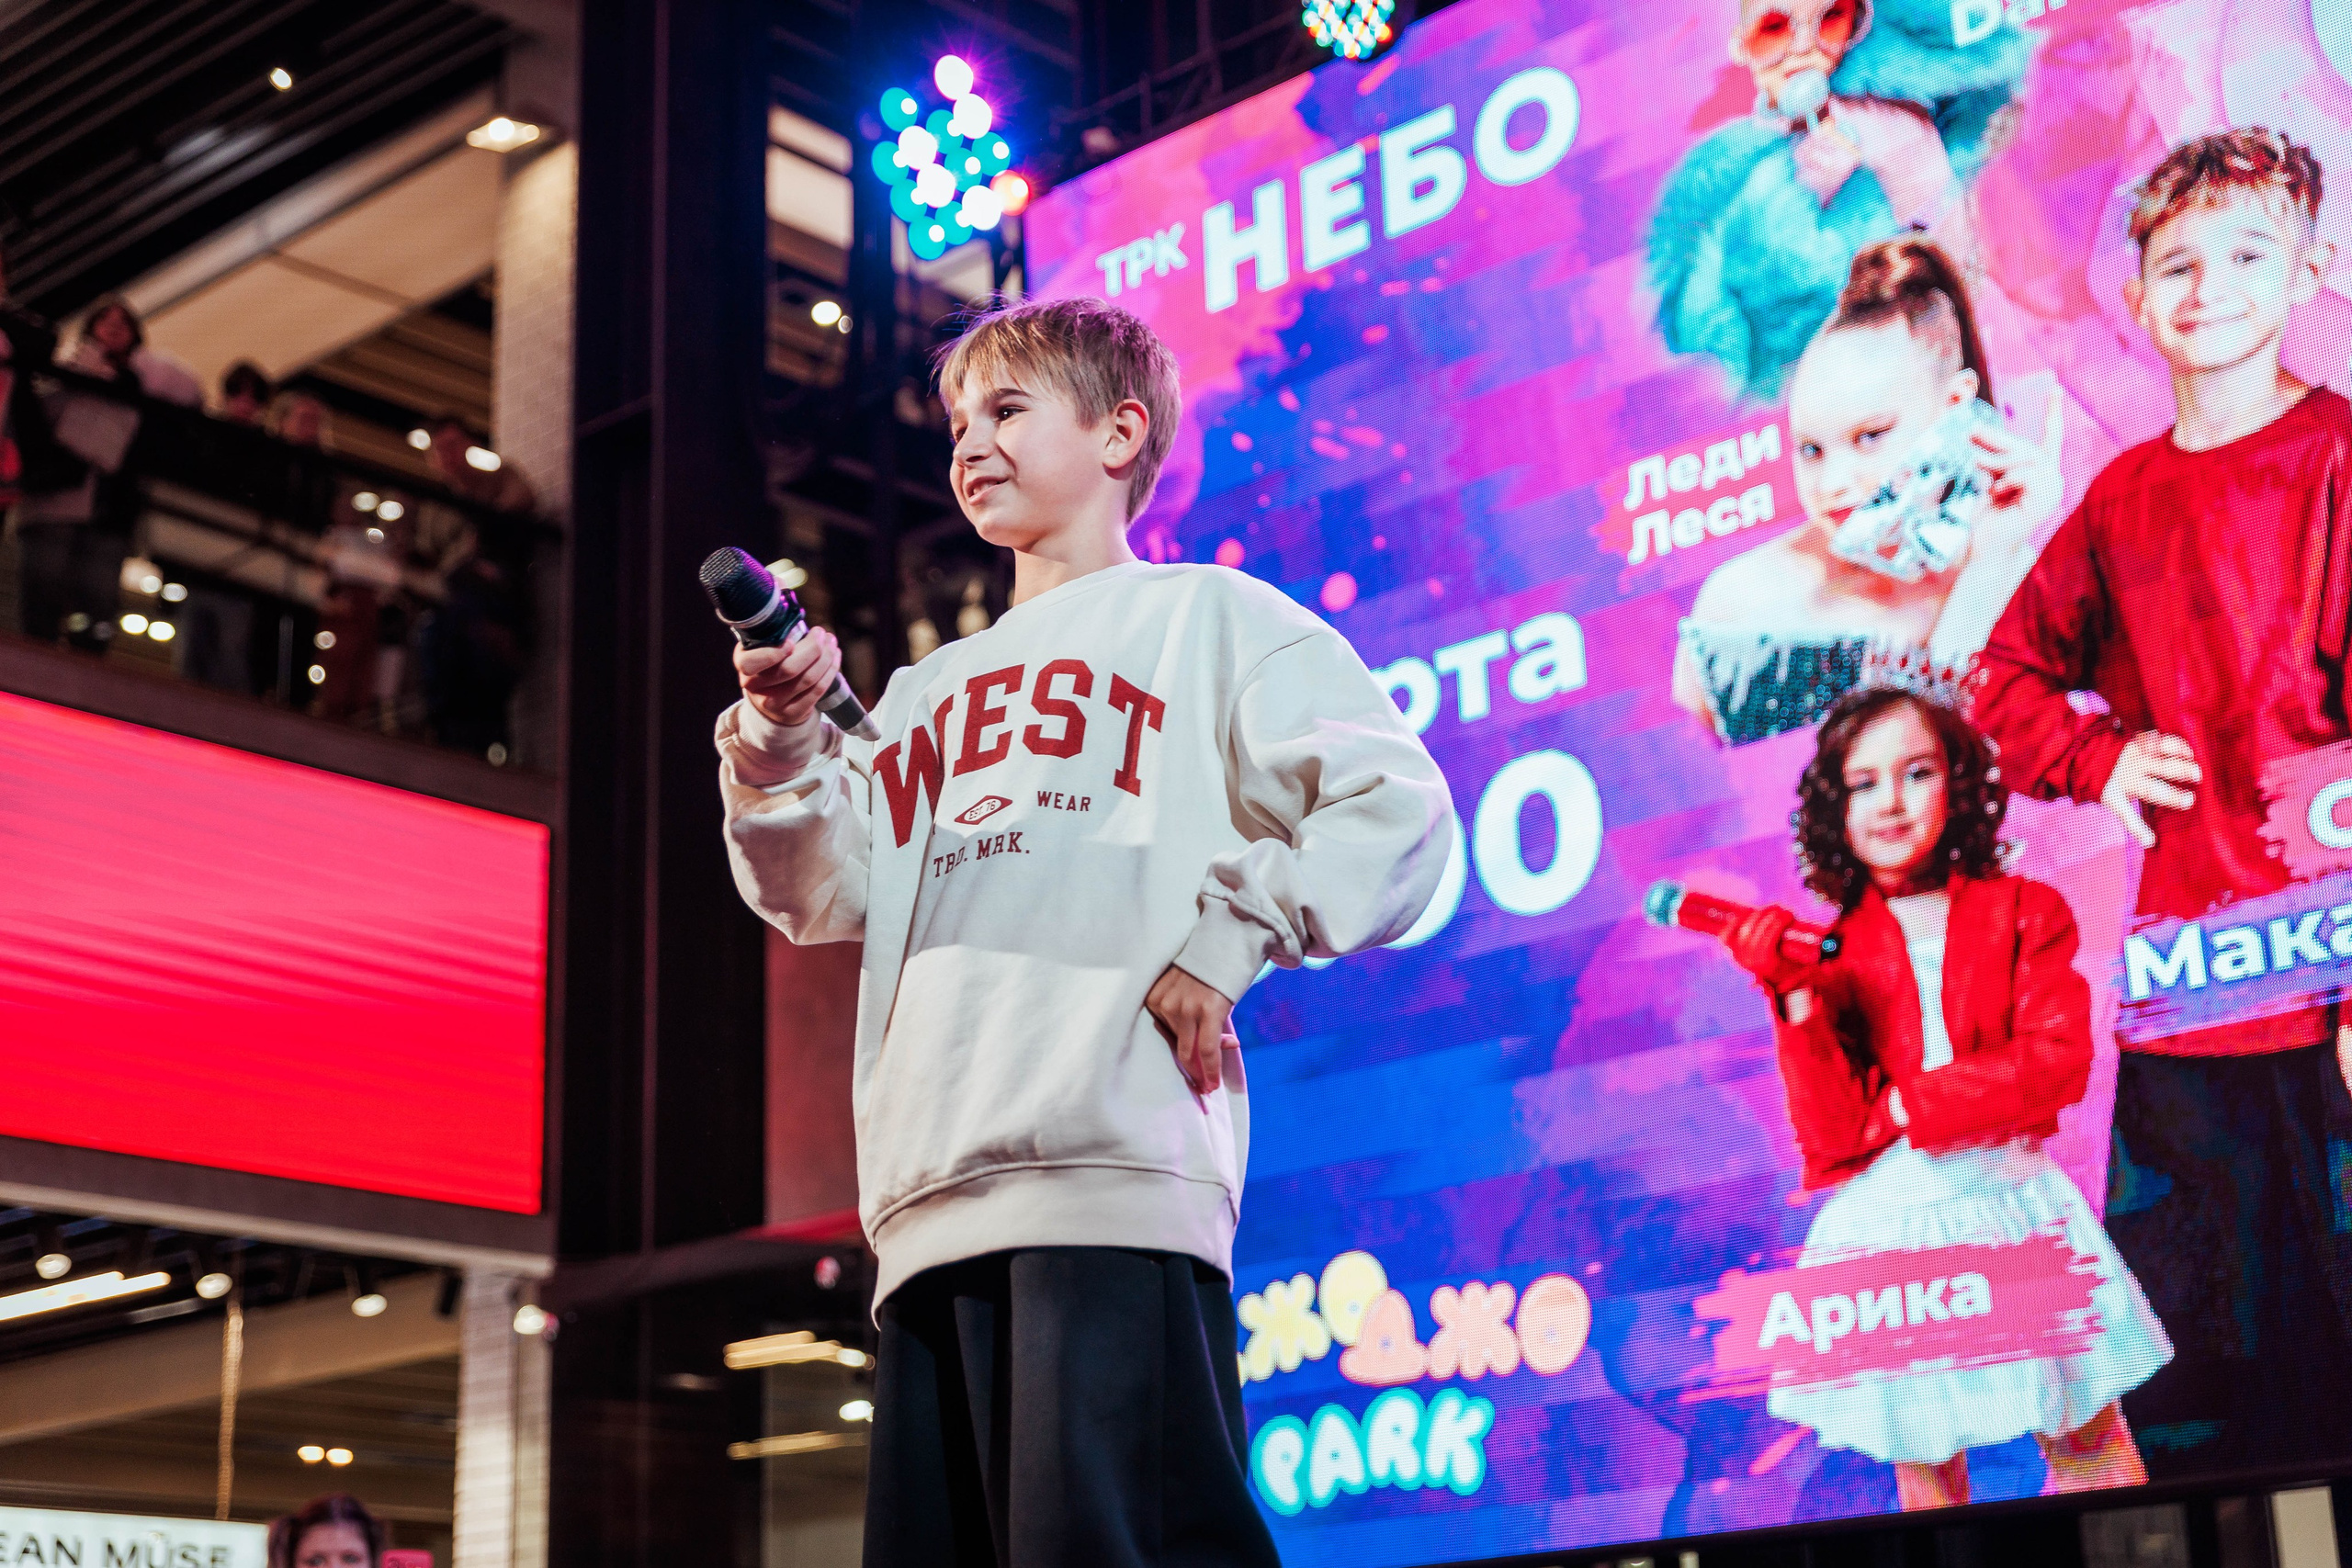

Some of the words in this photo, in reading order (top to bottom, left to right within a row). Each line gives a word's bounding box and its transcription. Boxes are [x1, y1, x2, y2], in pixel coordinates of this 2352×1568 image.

[1096, 220, 1189, 298] ТРК
[1203, 66, 1580, 313] НЕБО
[1623, 423, 1781, 512] Леди
[1627, 482, 1775, 565] Леся
[1370, 612, 1588, 736] рта
[873, 659, 1166, 849] WEST
[1037, 790, 1091, 812] WEAR
[976, 831, 1030, 861] MRK.
[1758, 1271, 1992, 1354] Арика
[1253, 1388, 1495, 1517] PARK
